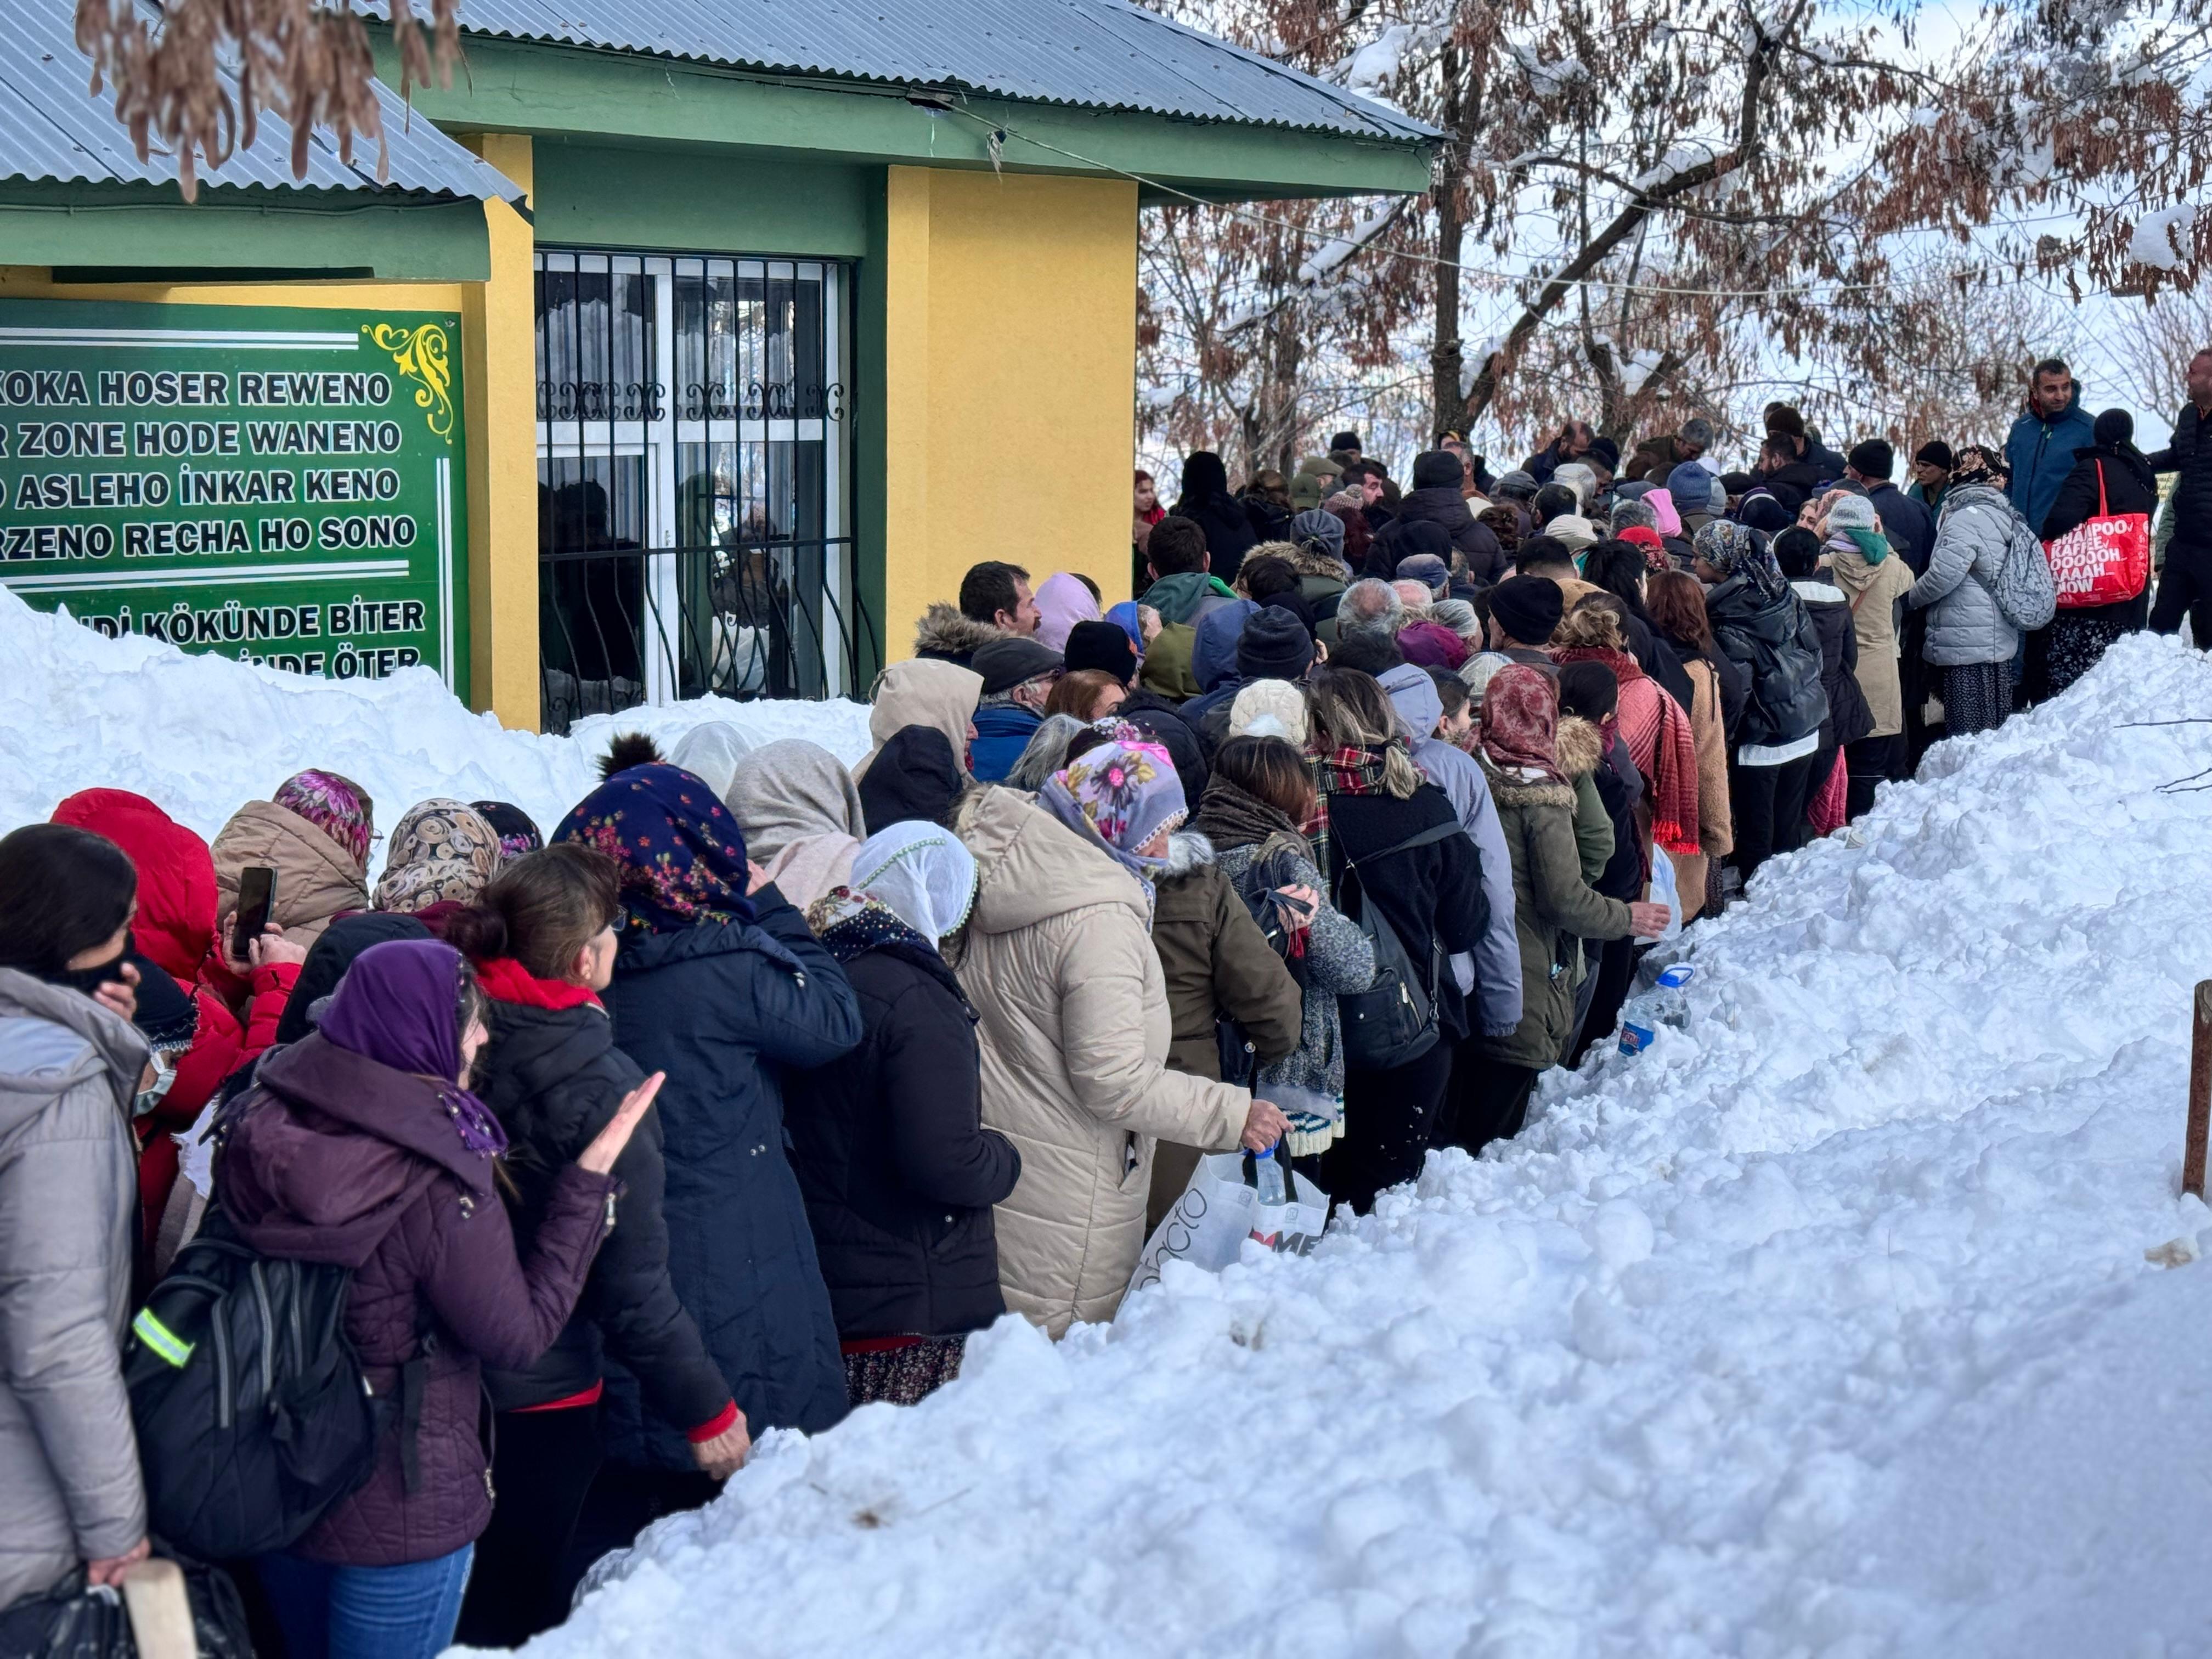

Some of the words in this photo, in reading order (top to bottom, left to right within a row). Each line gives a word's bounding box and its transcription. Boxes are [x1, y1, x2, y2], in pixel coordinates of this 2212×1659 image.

[98, 371, 229, 406] HOSER
[238, 372, 392, 406] REWENO
[18, 422, 126, 458] ZONE
[134, 422, 240, 456] HODE
[246, 420, 402, 455] WANENO
[15, 472, 171, 510] ASLEHO
[179, 462, 296, 506] İNKAR
[304, 468, 400, 503] KENO
[123, 520, 252, 558] RECHA
[259, 517, 312, 552] HO
[318, 514, 417, 550] SONO
[142, 600, 320, 645] KÖKÜNDE
[328, 595, 425, 636] BİTER
